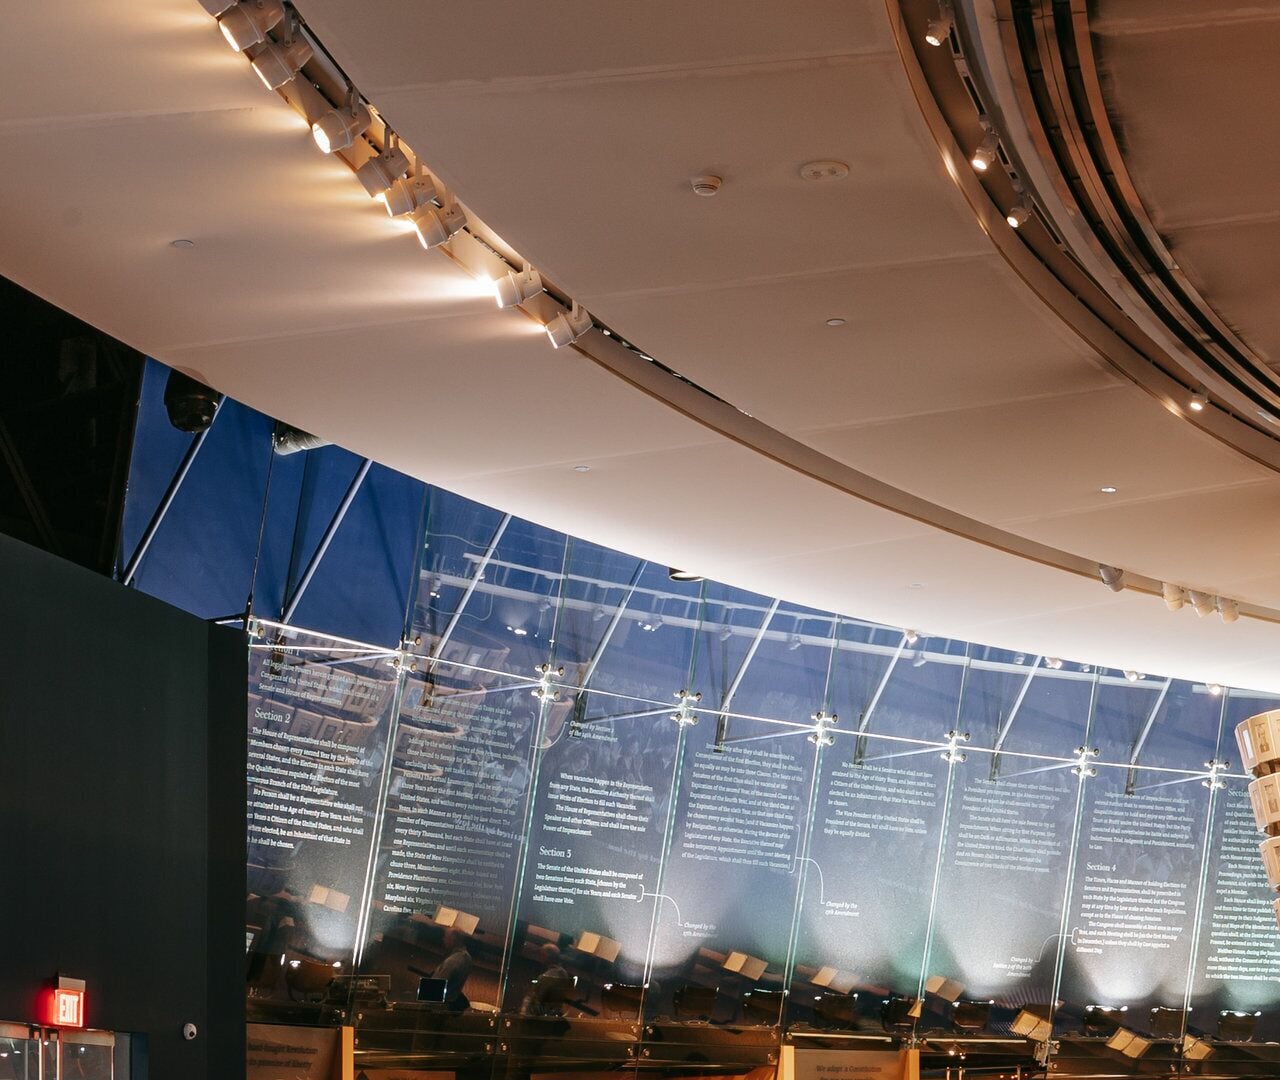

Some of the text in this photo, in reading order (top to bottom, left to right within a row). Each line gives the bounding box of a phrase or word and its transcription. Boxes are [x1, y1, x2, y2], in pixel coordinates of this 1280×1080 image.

[255, 707, 291, 723] Section 2
[539, 845, 565, 857] Section
[1086, 862, 1117, 872] Section 4
[60, 994, 79, 1023] EXIT
